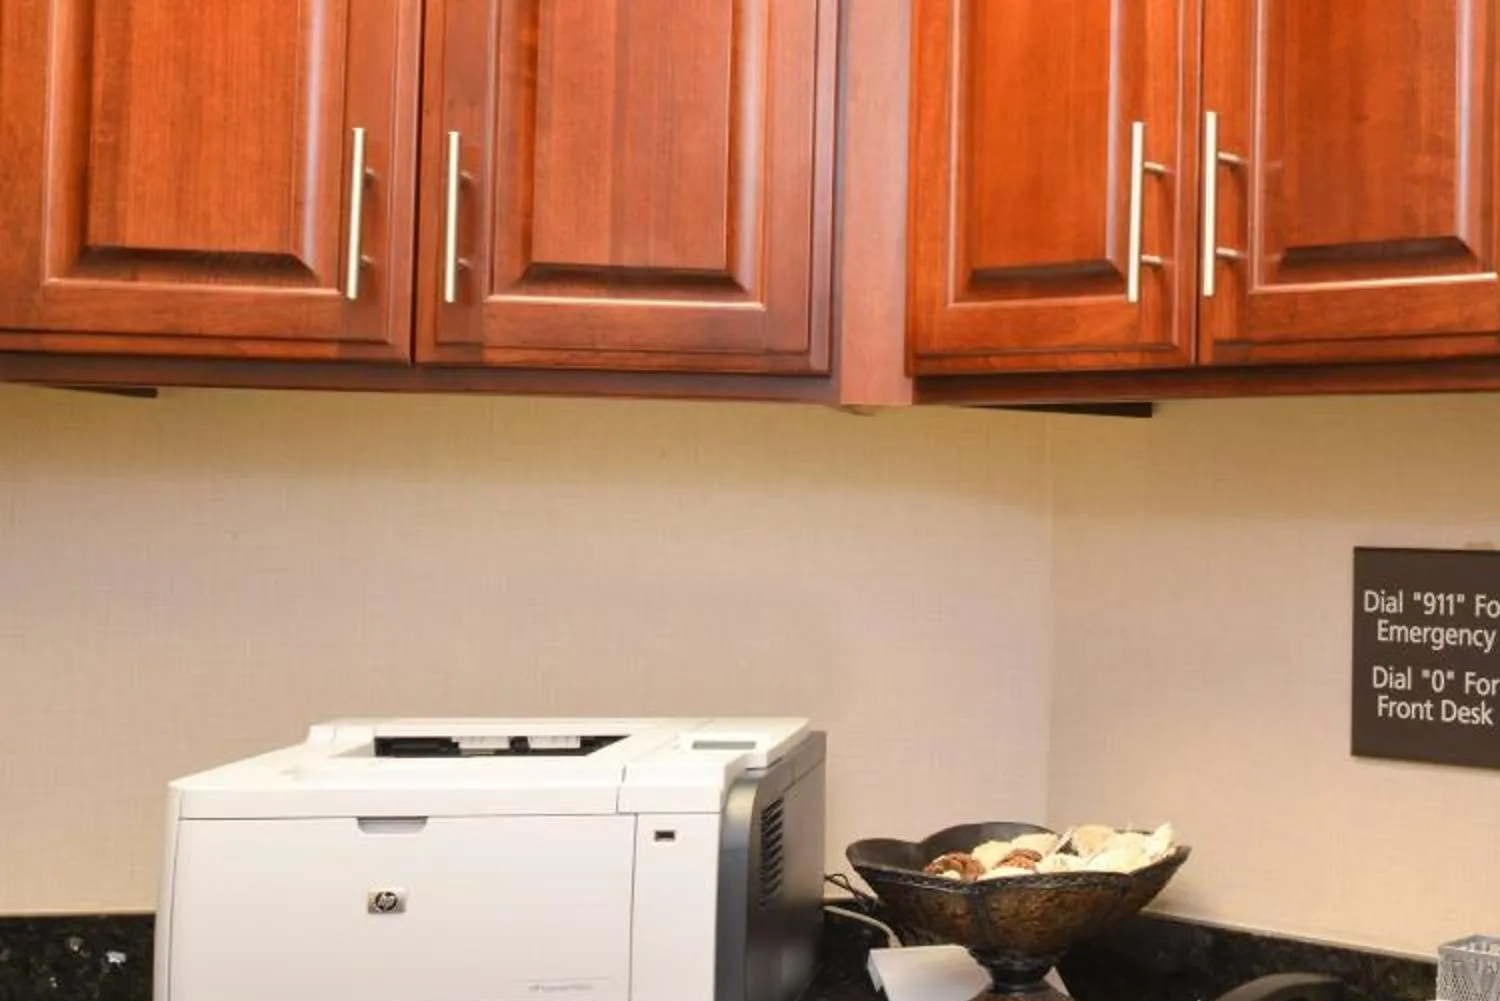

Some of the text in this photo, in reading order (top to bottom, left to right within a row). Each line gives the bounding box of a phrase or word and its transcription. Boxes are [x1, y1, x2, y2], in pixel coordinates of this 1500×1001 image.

[1362, 589, 1404, 614] Dial
[1413, 591, 1465, 616] "911"
[1377, 619, 1496, 653] Emergency
[1372, 665, 1413, 691] Dial
[1421, 668, 1454, 693] "0"
[1377, 695, 1494, 726] Front Desk
